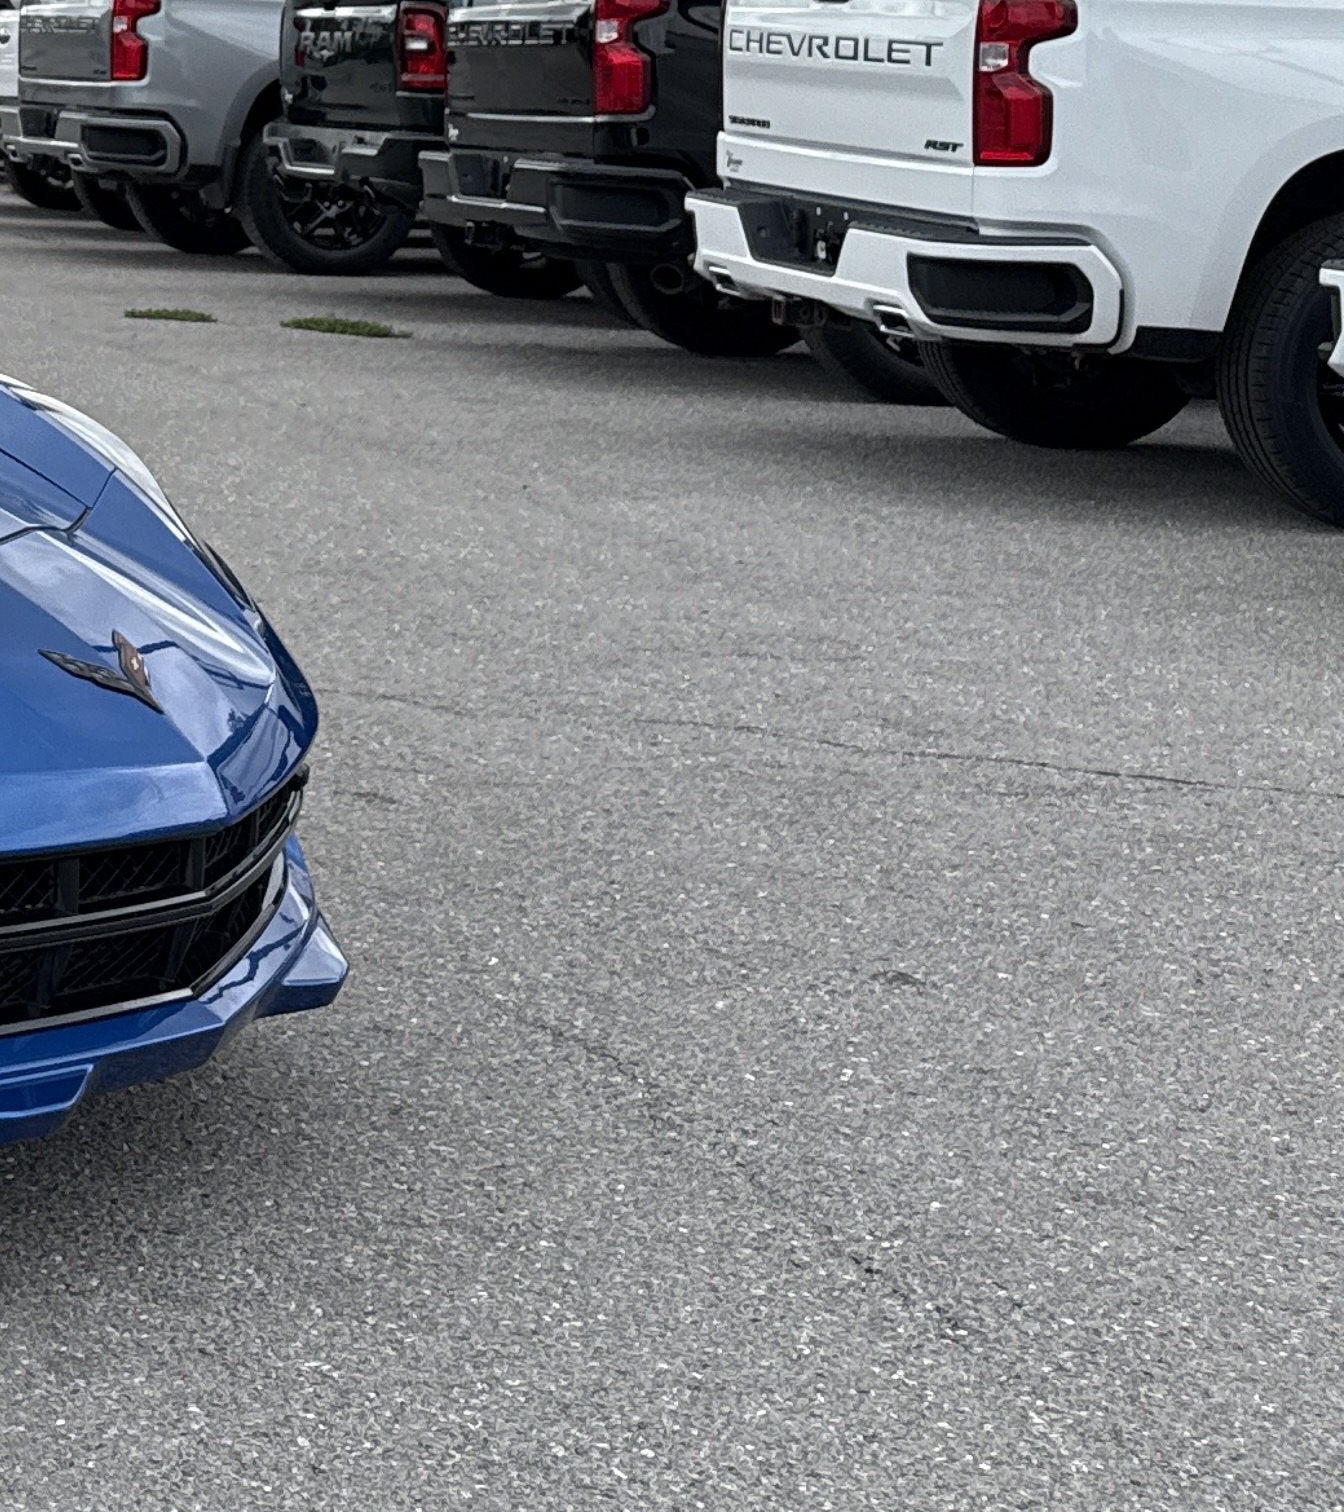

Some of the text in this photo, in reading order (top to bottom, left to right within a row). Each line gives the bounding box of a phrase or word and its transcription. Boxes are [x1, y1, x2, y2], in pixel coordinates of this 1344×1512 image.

[300, 31, 353, 55] RAM
[728, 28, 944, 67] CHEVROLET
[924, 139, 964, 153] RST
